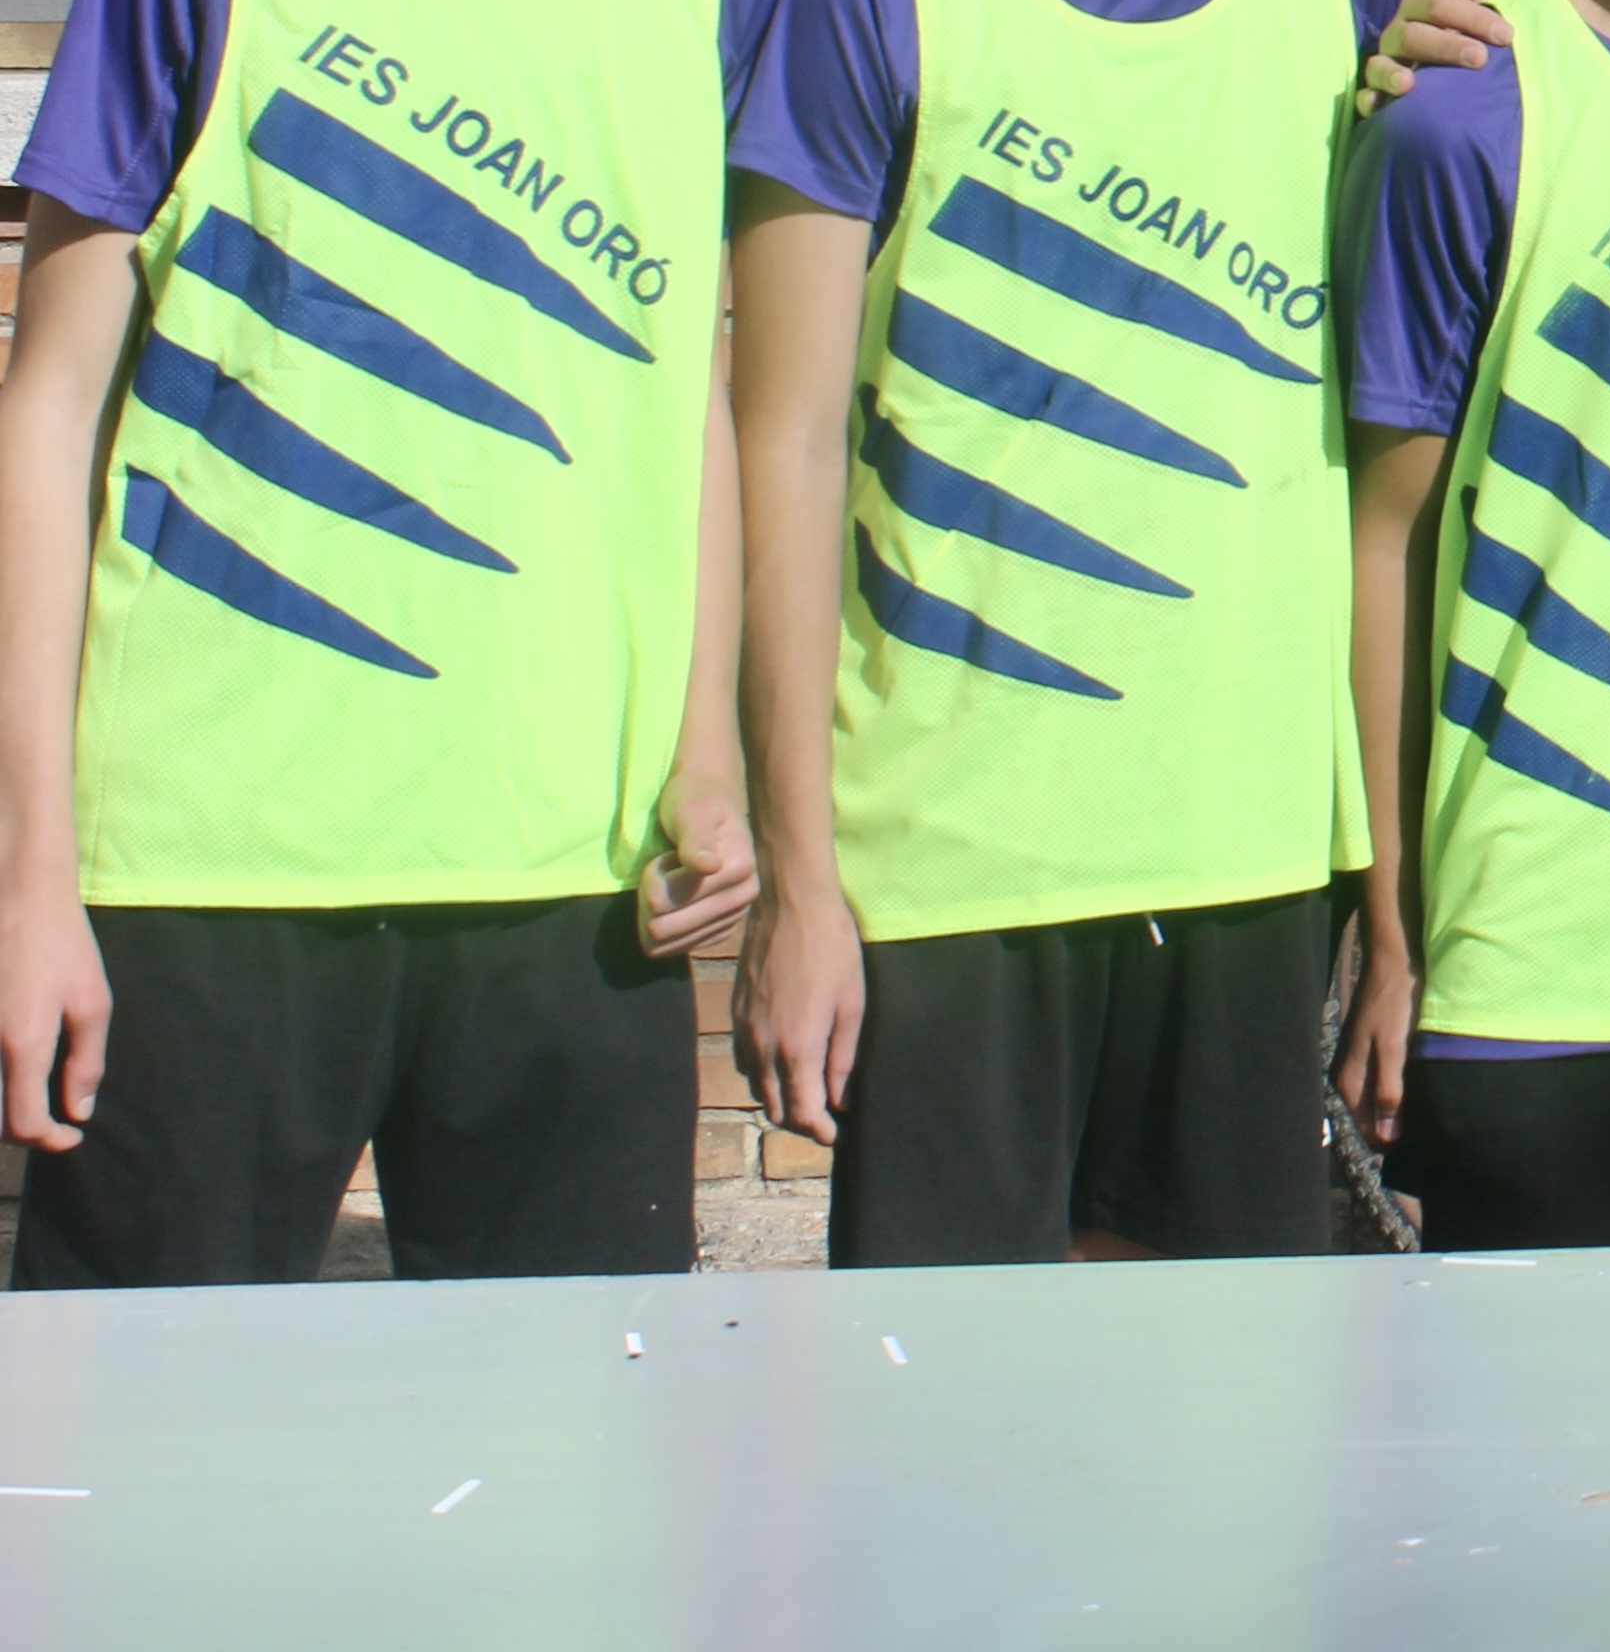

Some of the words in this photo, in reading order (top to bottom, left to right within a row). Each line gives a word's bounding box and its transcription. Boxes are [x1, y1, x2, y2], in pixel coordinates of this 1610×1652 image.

[297, 24, 411, 106] IES
[410, 94, 565, 214] JOAN
[561, 199, 673, 306] ORÓ
[978, 108, 1075, 184] IES
[1078, 164, 1228, 260] JOAN
[1226, 241, 1330, 330] ORÓ
